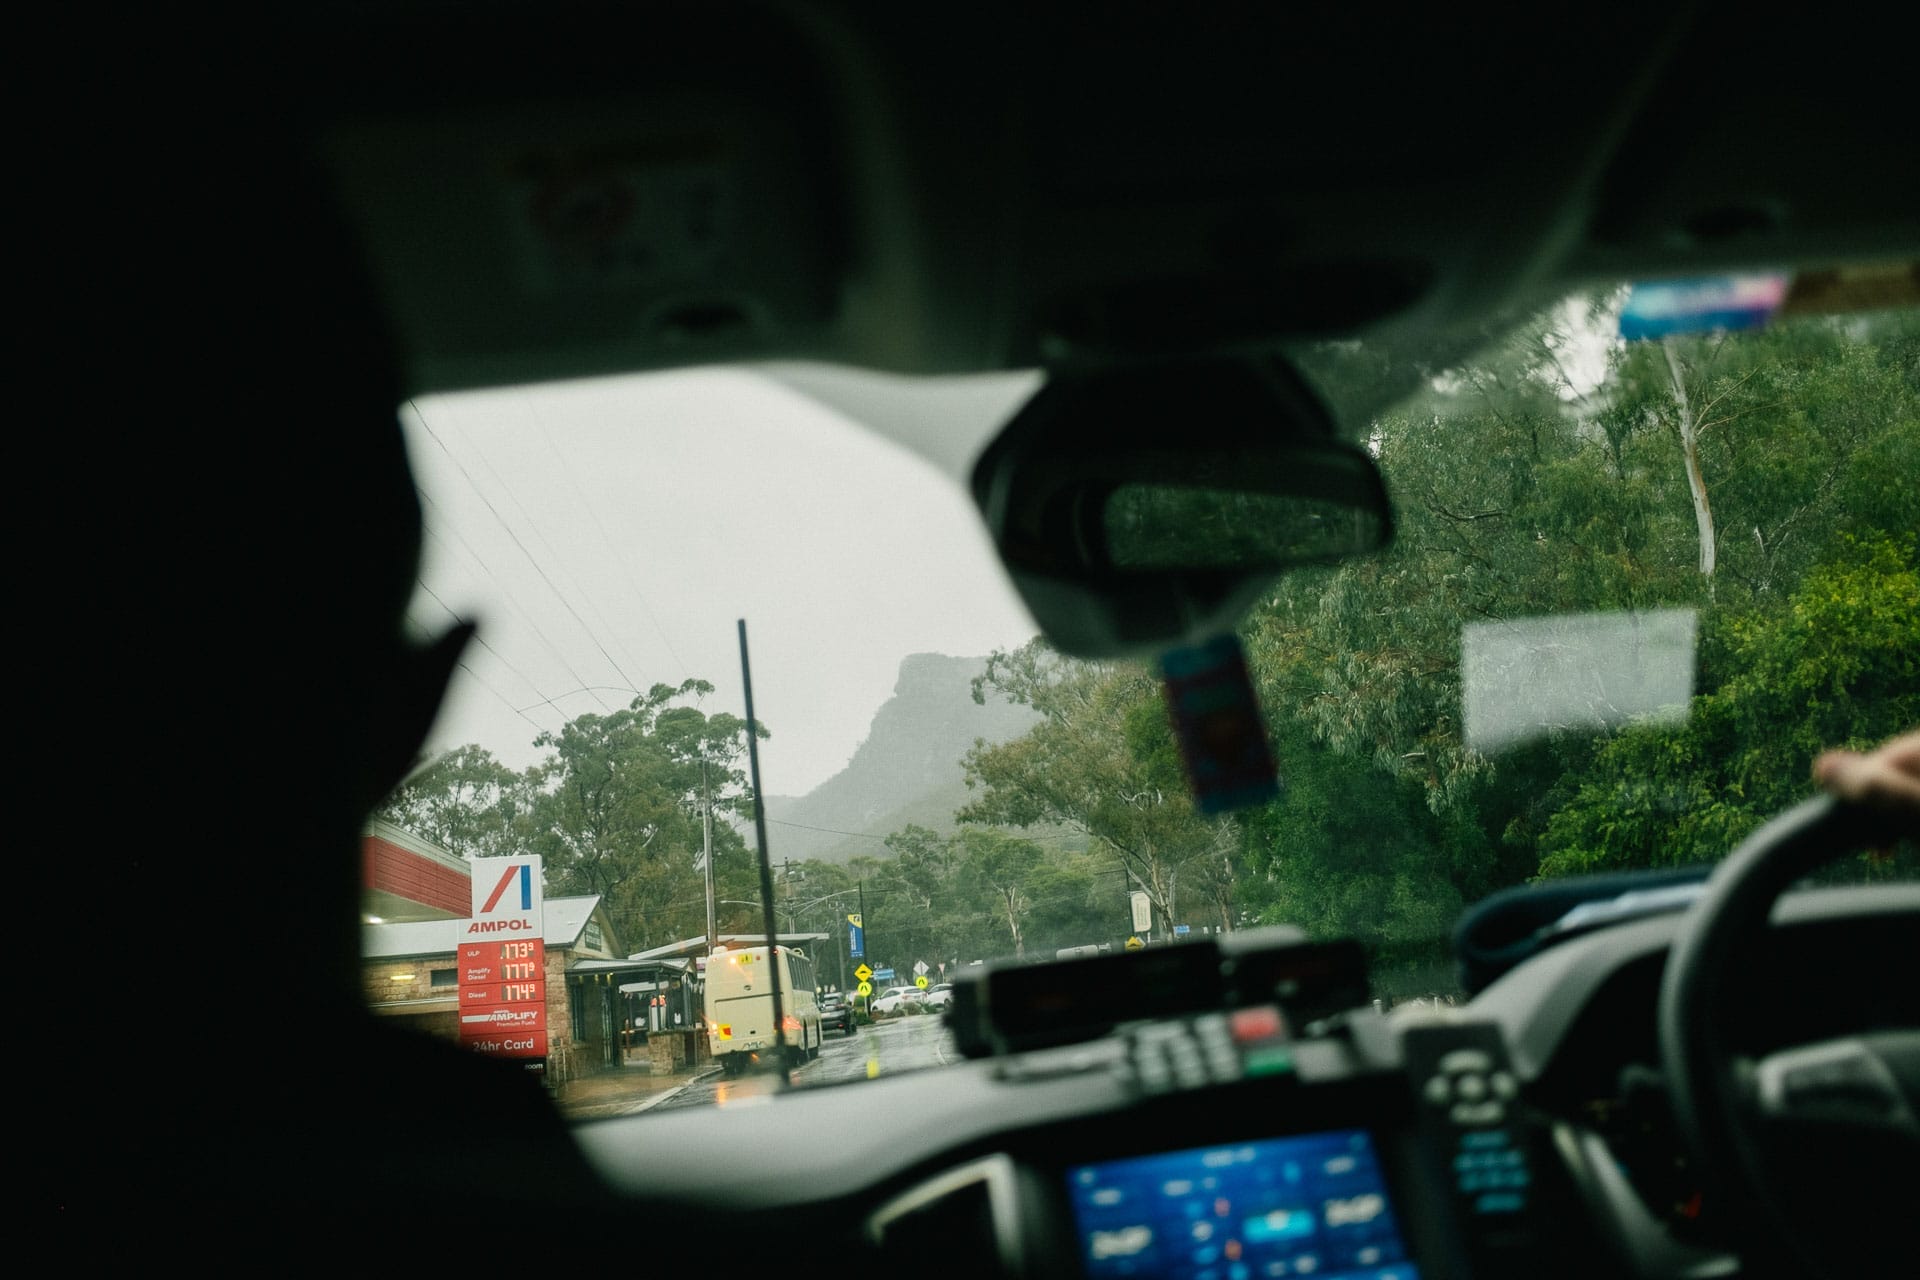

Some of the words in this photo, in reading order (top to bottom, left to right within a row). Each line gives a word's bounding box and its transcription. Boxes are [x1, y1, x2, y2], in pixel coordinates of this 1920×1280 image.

[468, 919, 533, 934] AMPOL
[467, 967, 491, 975] Amplify
[468, 991, 487, 999] Diesel
[488, 1011, 538, 1022] AMPLIFY
[473, 1040, 501, 1053] 24hr
[503, 1038, 534, 1050] Card
